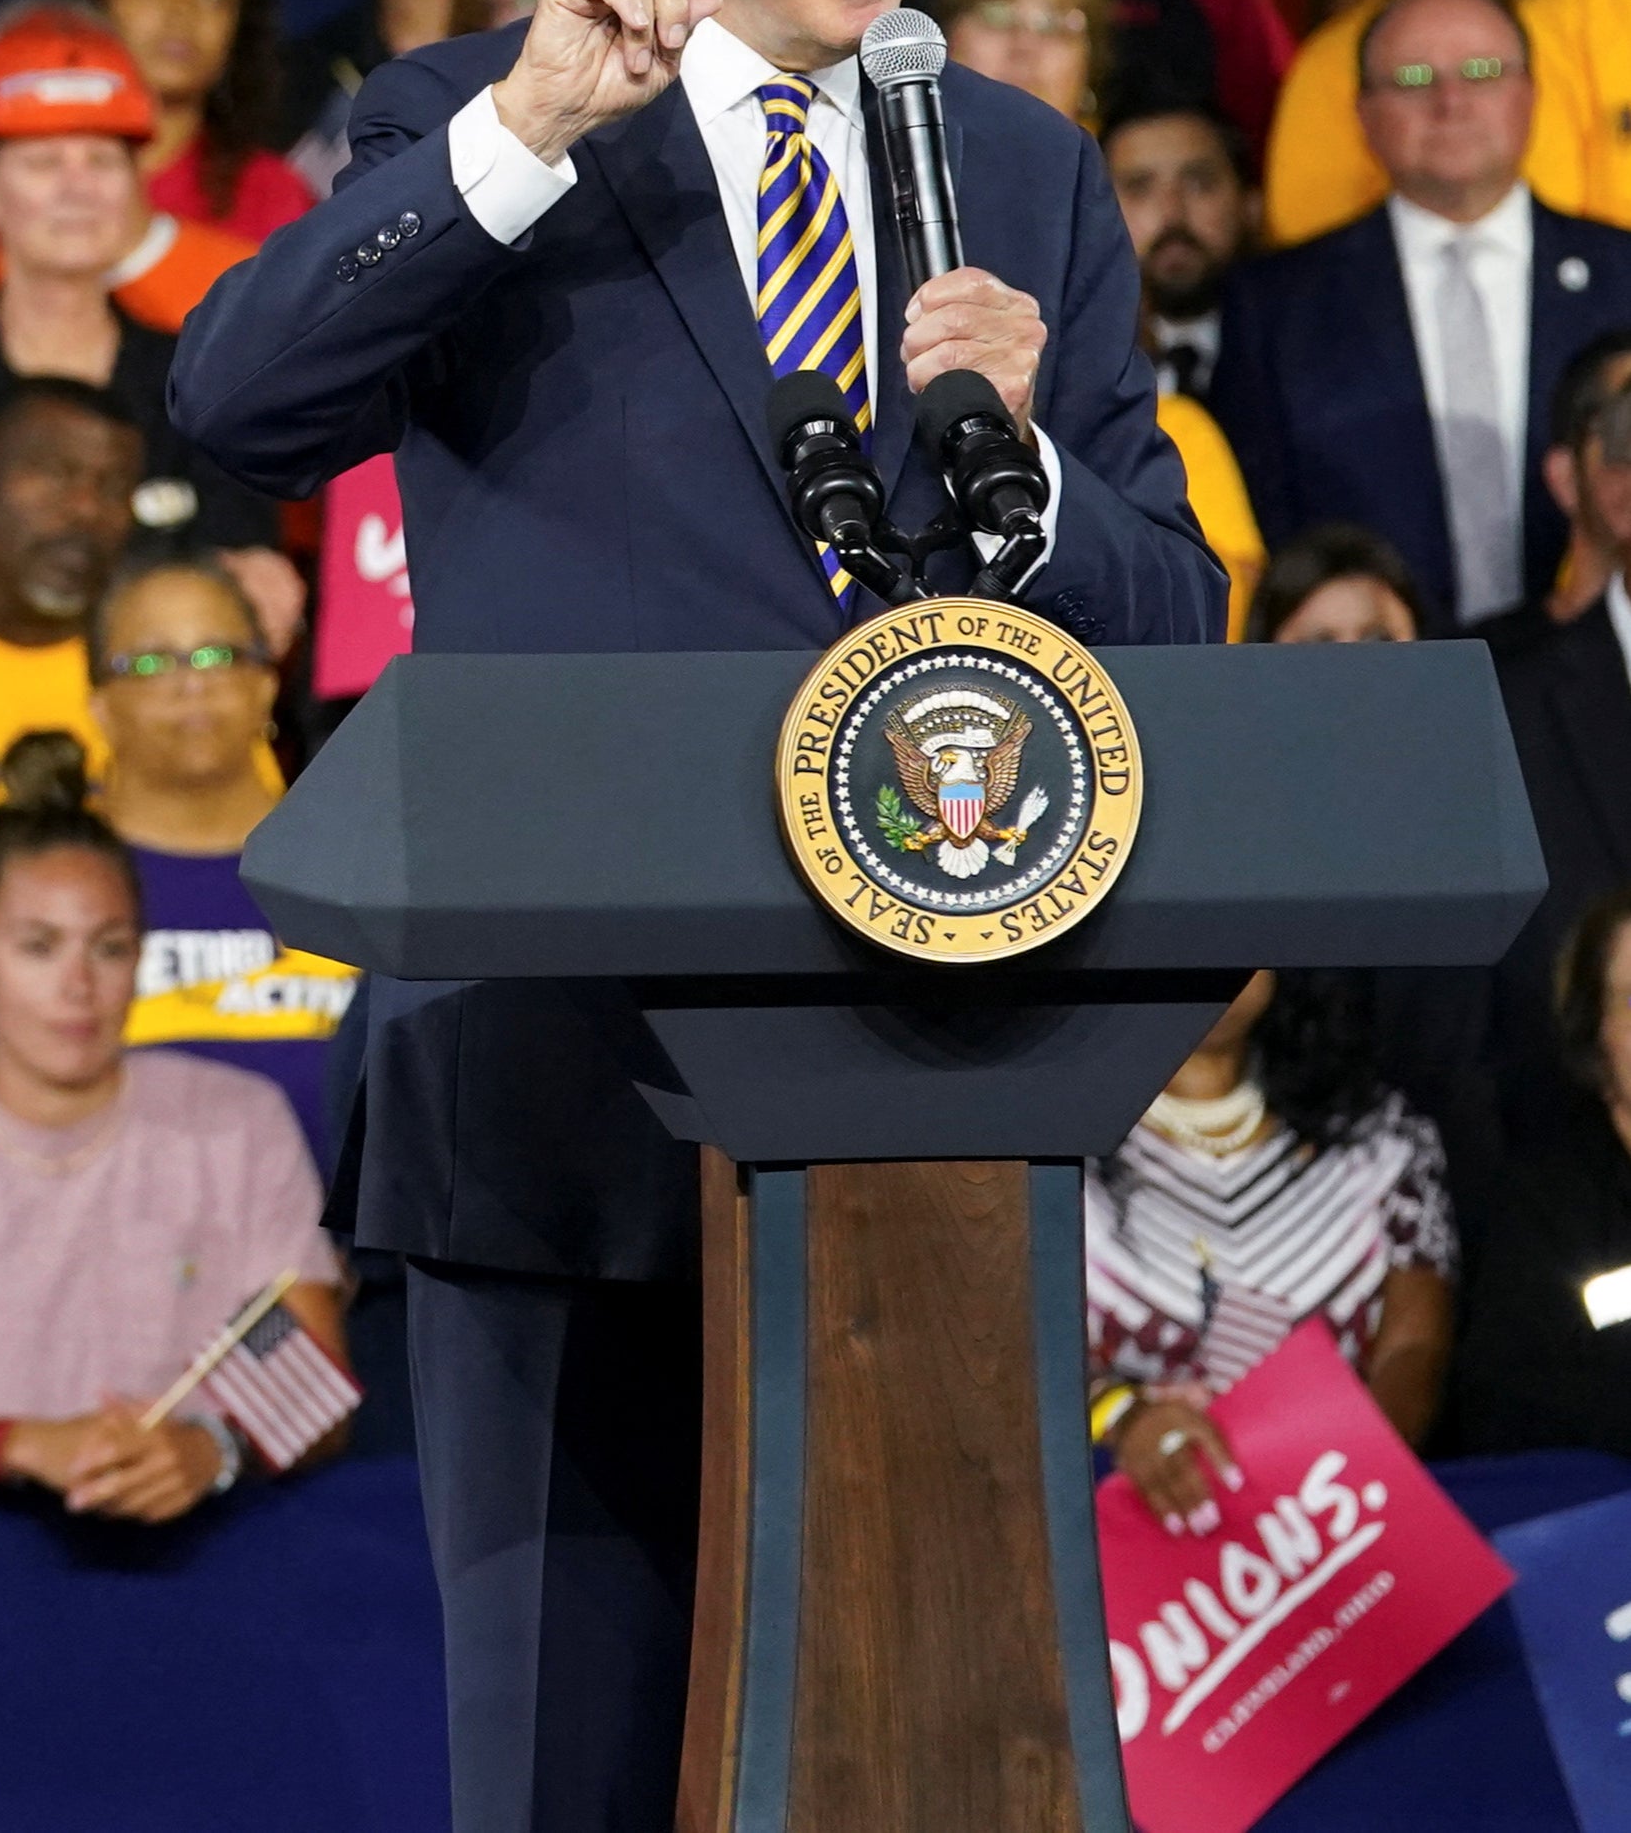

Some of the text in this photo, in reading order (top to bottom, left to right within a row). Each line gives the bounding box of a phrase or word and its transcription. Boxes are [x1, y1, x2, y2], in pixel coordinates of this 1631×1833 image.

[793, 611, 1132, 946] SEAL OF THE PRESIDENT OF THE UNITED STATES
[136, 928, 276, 998] ETIRED
[1334, 1570, 1396, 1630] OHIO
